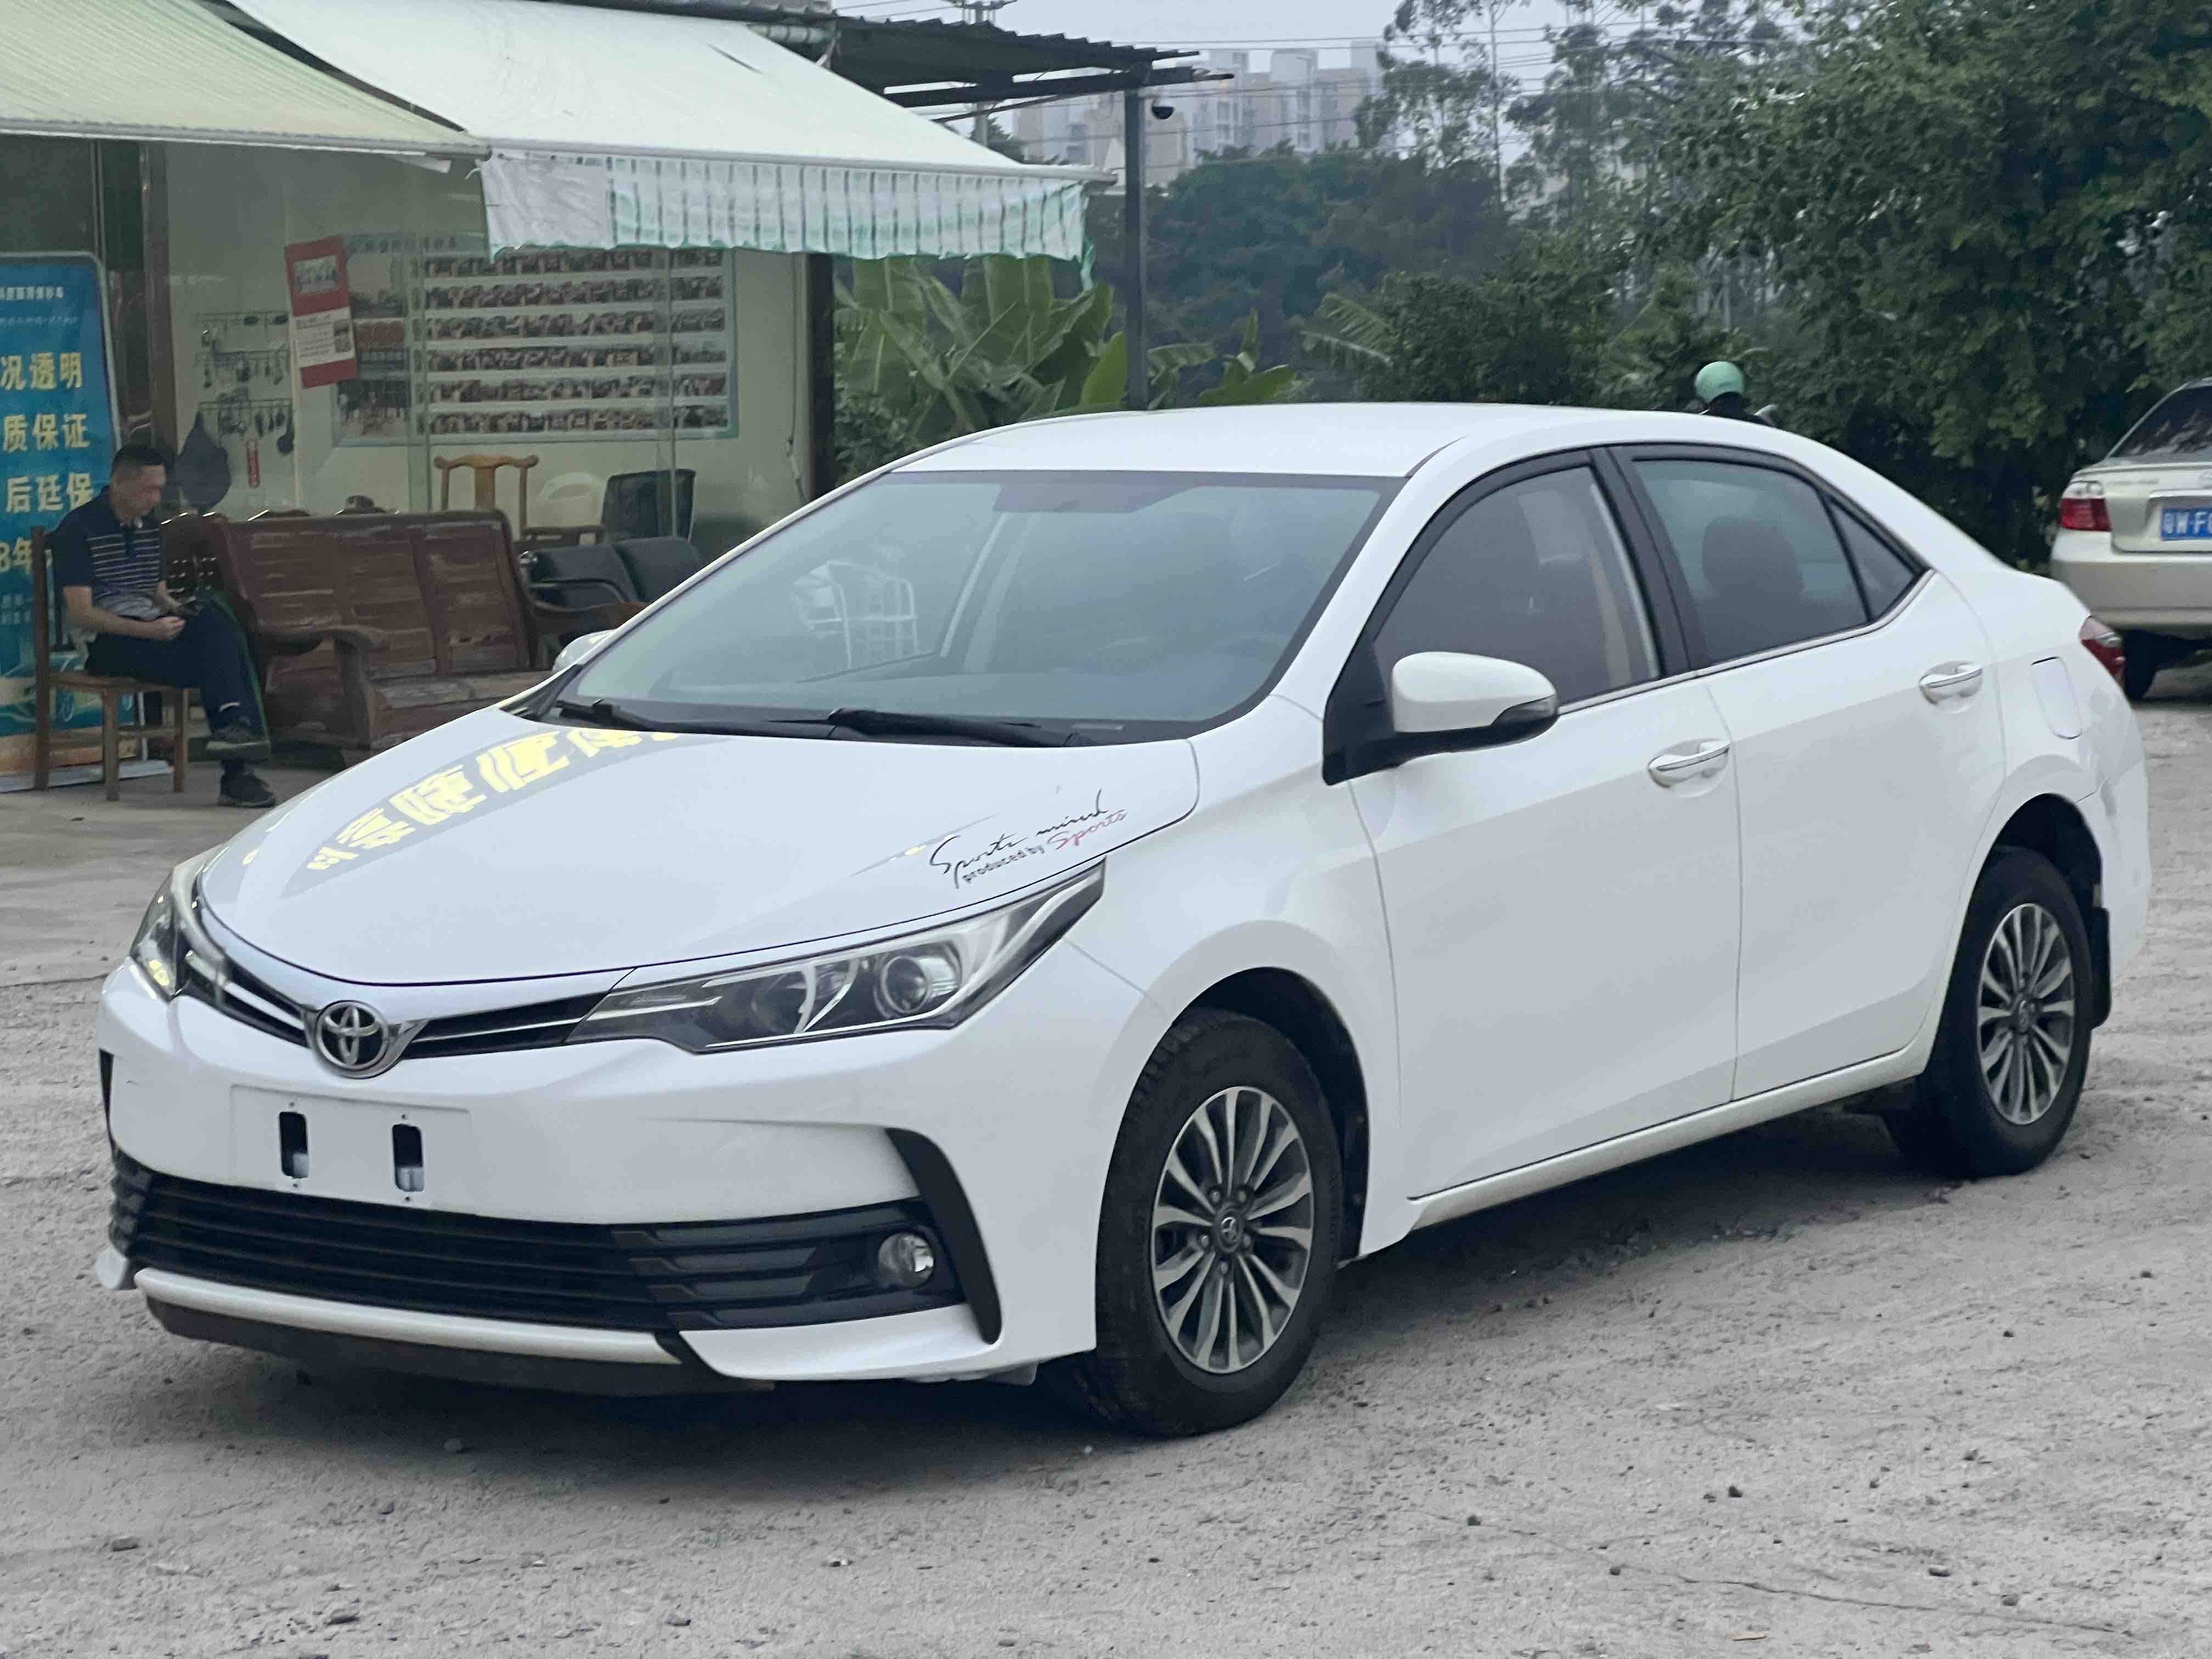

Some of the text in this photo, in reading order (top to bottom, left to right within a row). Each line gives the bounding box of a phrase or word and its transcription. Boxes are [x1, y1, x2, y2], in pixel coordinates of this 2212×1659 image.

[1, 352, 83, 390] 况透明
[3, 413, 90, 453] 质保证
[1036, 788, 1109, 836] mind
[962, 849, 1027, 884] produced
[1046, 809, 1127, 850] Sports
